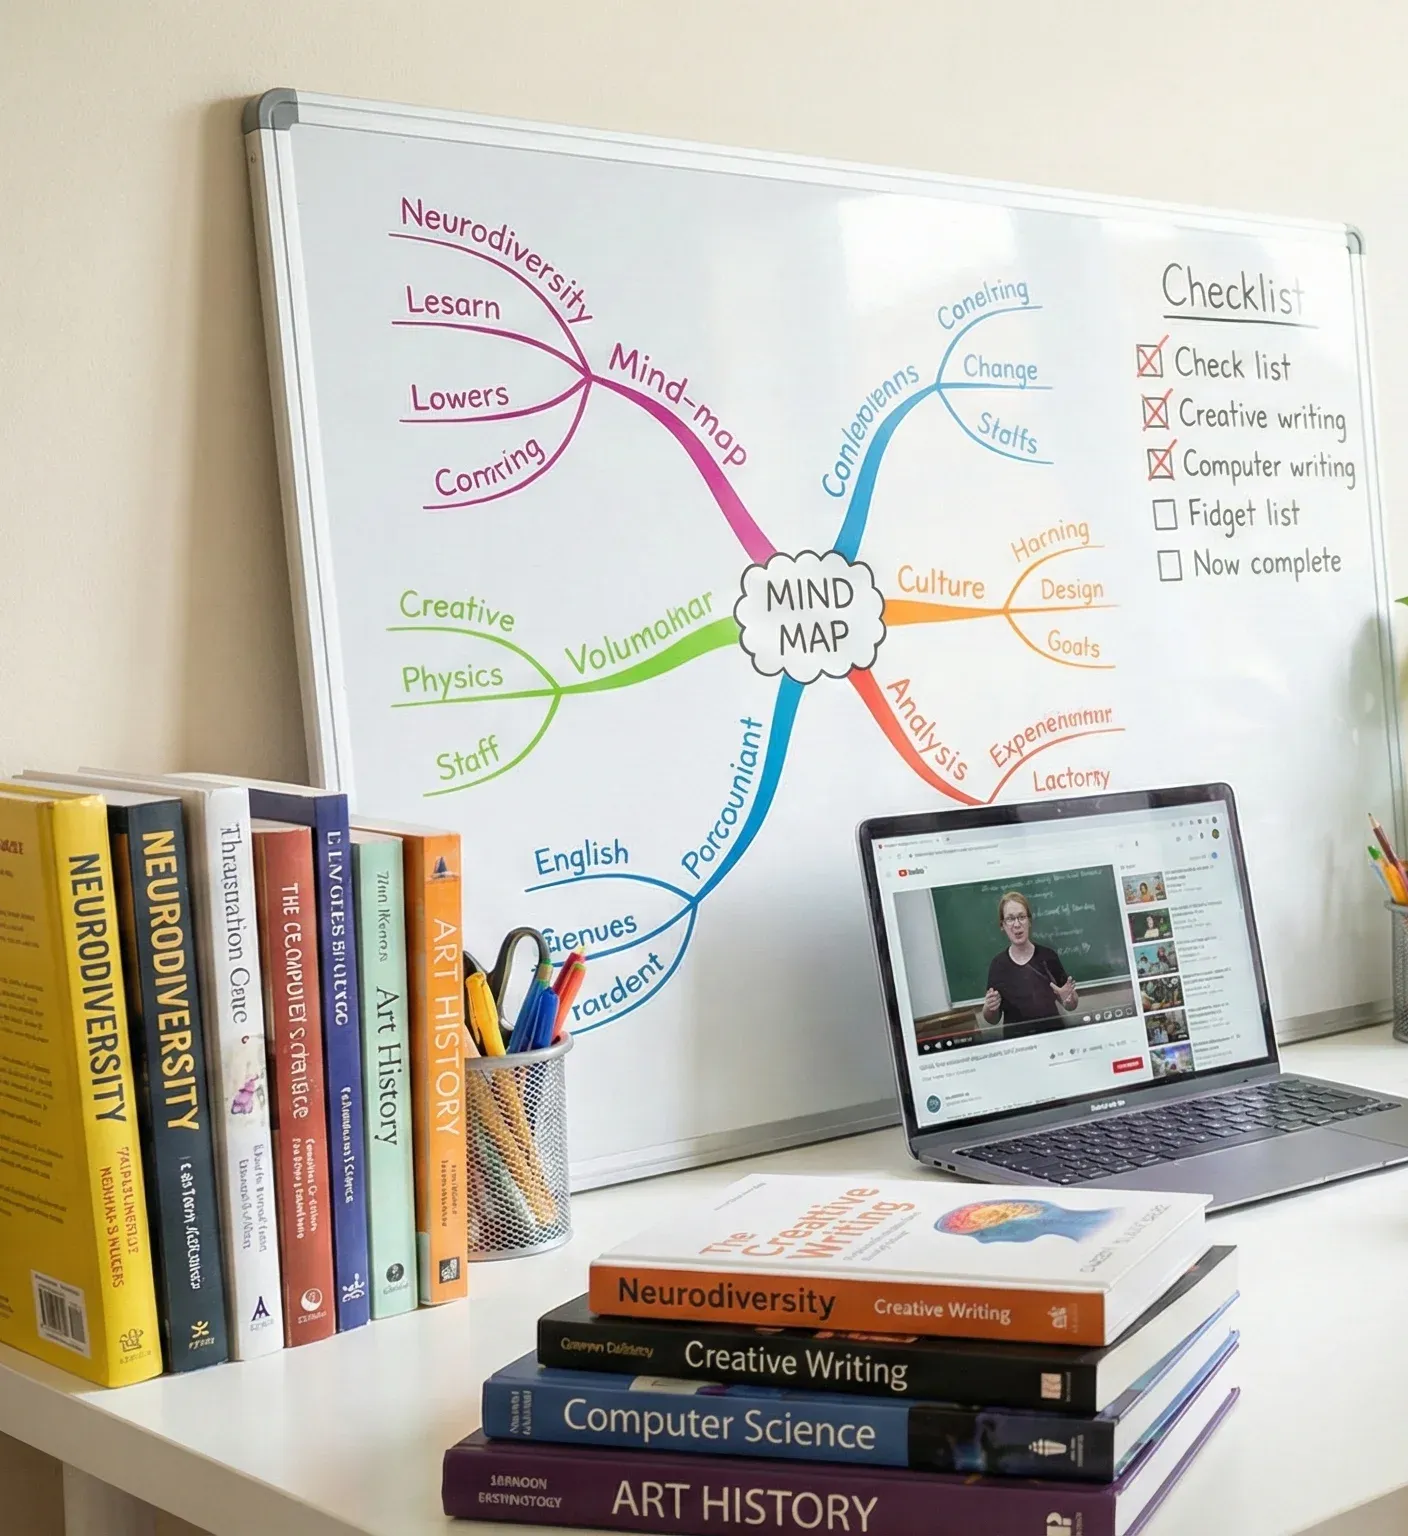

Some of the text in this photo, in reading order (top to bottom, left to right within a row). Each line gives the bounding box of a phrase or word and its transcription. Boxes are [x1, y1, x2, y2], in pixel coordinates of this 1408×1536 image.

[401, 196, 593, 325] Neurodiversity
[406, 285, 500, 320] Lesarn
[1162, 262, 1305, 316] Checklist
[963, 354, 1038, 389] Change
[1174, 346, 1291, 381] Check list
[411, 384, 509, 412] Lowers
[608, 342, 748, 467] Mind-map
[1179, 397, 1346, 443] Creative writing
[1183, 448, 1356, 490] Computer writing
[1188, 498, 1300, 538] Fidget list
[897, 565, 984, 599] Culture
[1194, 546, 1342, 582] Now complete
[399, 590, 516, 632] Creative
[767, 577, 854, 612] MIND
[1041, 577, 1104, 606] Design
[779, 620, 850, 655] MAP
[402, 664, 503, 700] Physics
[886, 676, 968, 782] Analysis
[436, 735, 500, 781] Staff
[534, 838, 629, 876] English
[281, 883, 299, 916] THE
[68, 853, 127, 1122] NEURODIVERSITY
[141, 830, 200, 1130] NEURODIVERSITY
[376, 987, 400, 1034] Art
[434, 918, 461, 1137] ART HISTORY
[374, 1042, 402, 1145] History
[699, 1232, 757, 1255] The
[741, 1187, 880, 1257] Creative
[785, 1201, 915, 1259] Writing
[618, 1276, 836, 1321] Neurodiversity
[874, 1299, 1011, 1326] Creative Writing
[685, 1341, 797, 1376] Creative
[805, 1349, 909, 1391] Writing
[564, 1398, 734, 1444] Computer
[744, 1409, 876, 1451] Science
[611, 1480, 879, 1533] ART HISTORY
